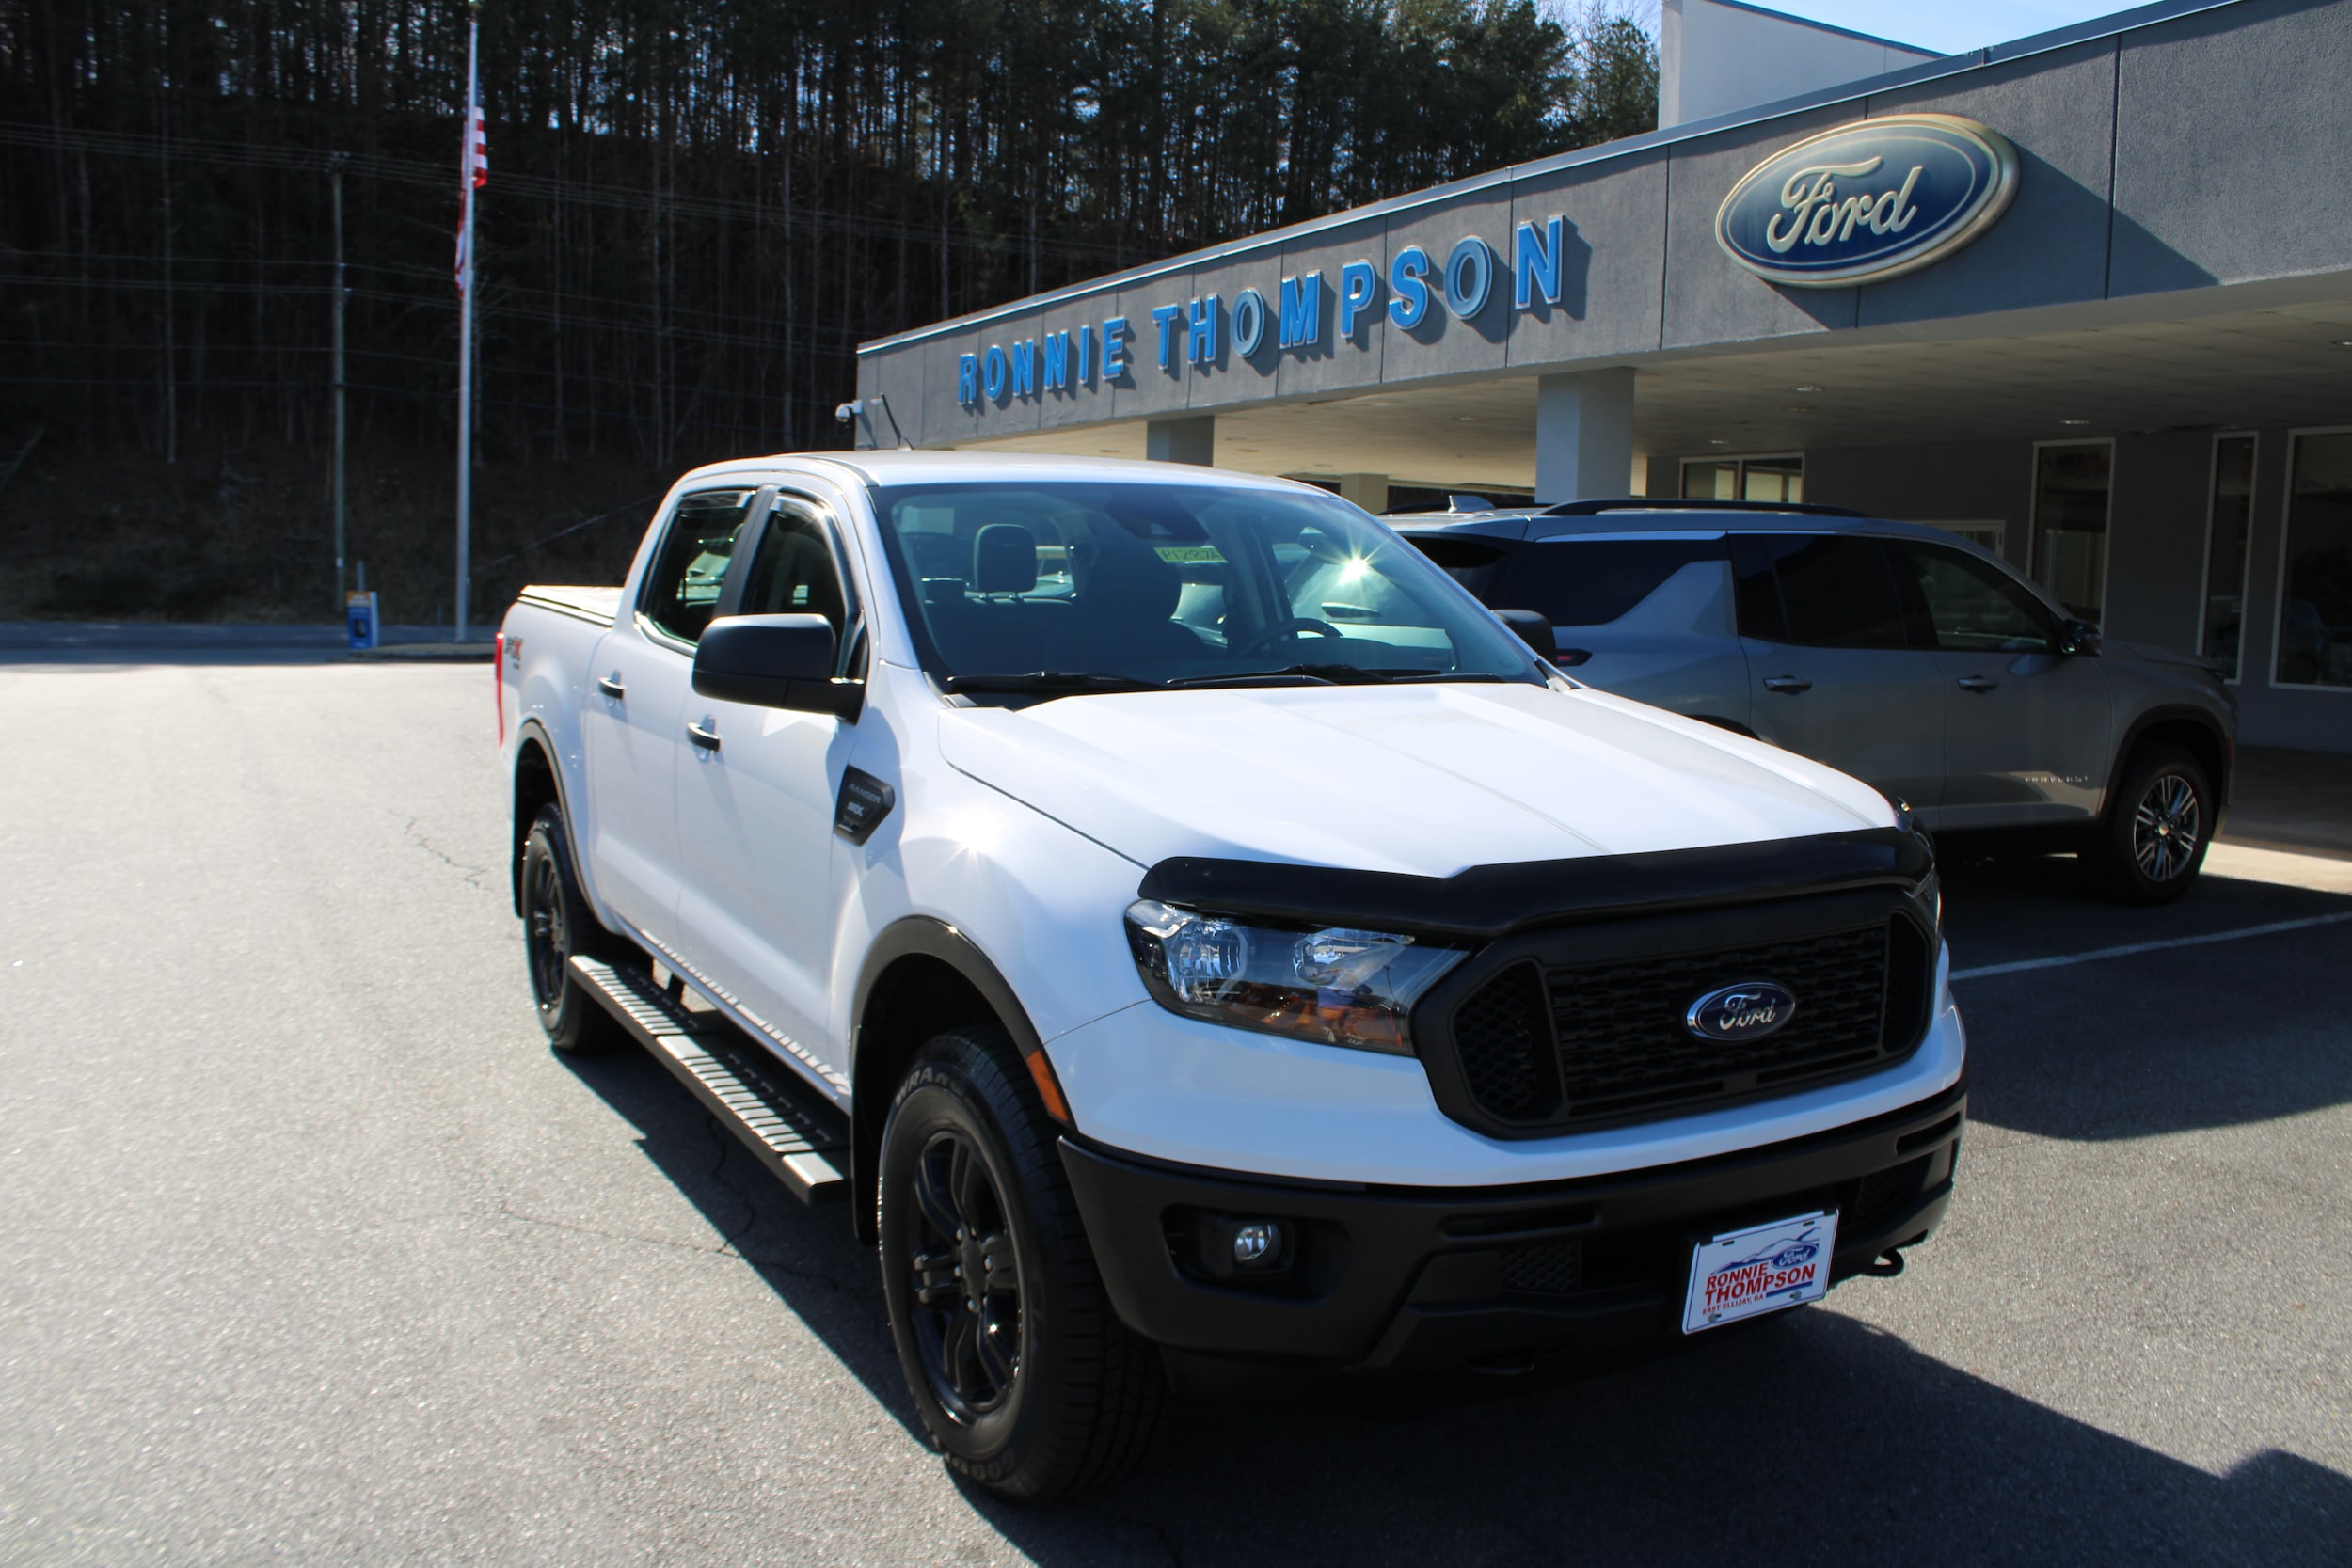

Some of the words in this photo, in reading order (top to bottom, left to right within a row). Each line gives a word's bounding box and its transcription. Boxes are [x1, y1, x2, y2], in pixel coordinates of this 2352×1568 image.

[1766, 155, 1924, 254] Ford
[957, 316, 1125, 407] RONNIE
[1152, 213, 1565, 371] THOMPSON
[1720, 992, 1776, 1030] Ford
[1779, 1248, 1808, 1265] Ford
[1705, 1264, 1816, 1306] THOMPSON
[1707, 1263, 1769, 1290] RONNIE
[1702, 1304, 1722, 1316] EAST
[1723, 1296, 1752, 1309] ELLIJAY,
